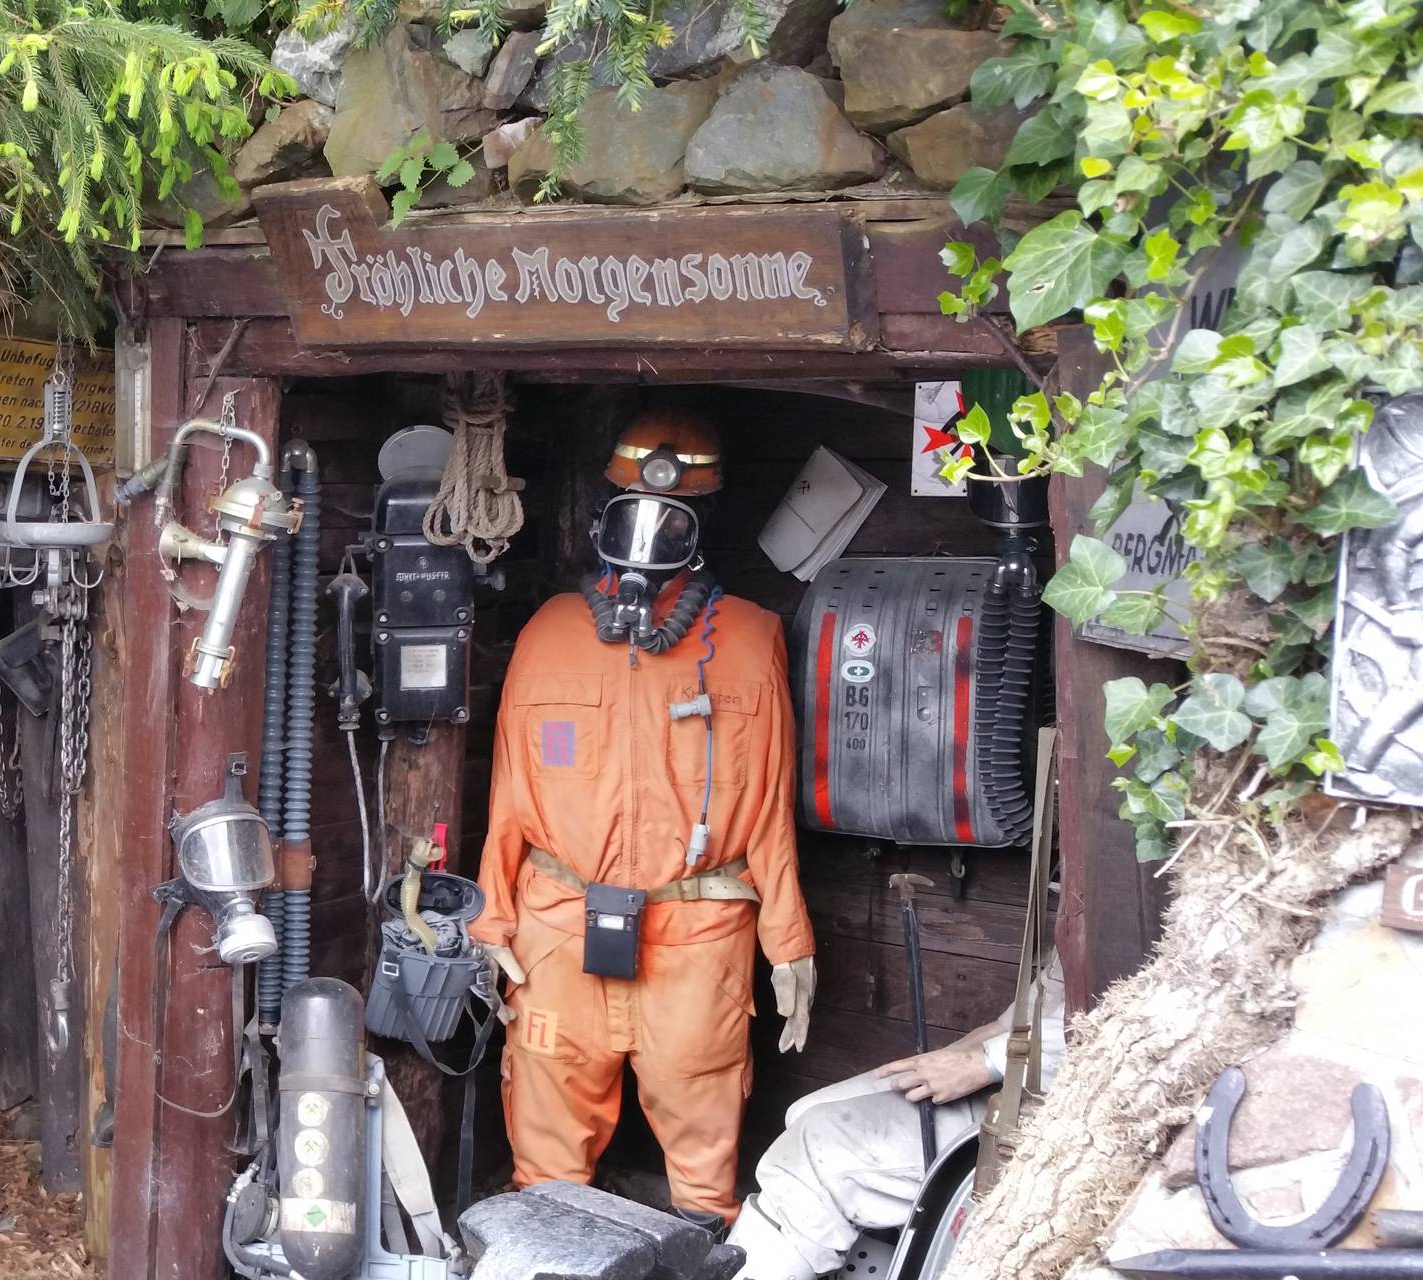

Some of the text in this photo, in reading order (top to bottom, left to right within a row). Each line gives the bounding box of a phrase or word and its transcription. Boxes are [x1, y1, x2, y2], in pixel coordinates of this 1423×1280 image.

[302, 204, 827, 322] Fröhliche Morgensonne
[845, 737, 866, 751] 400
